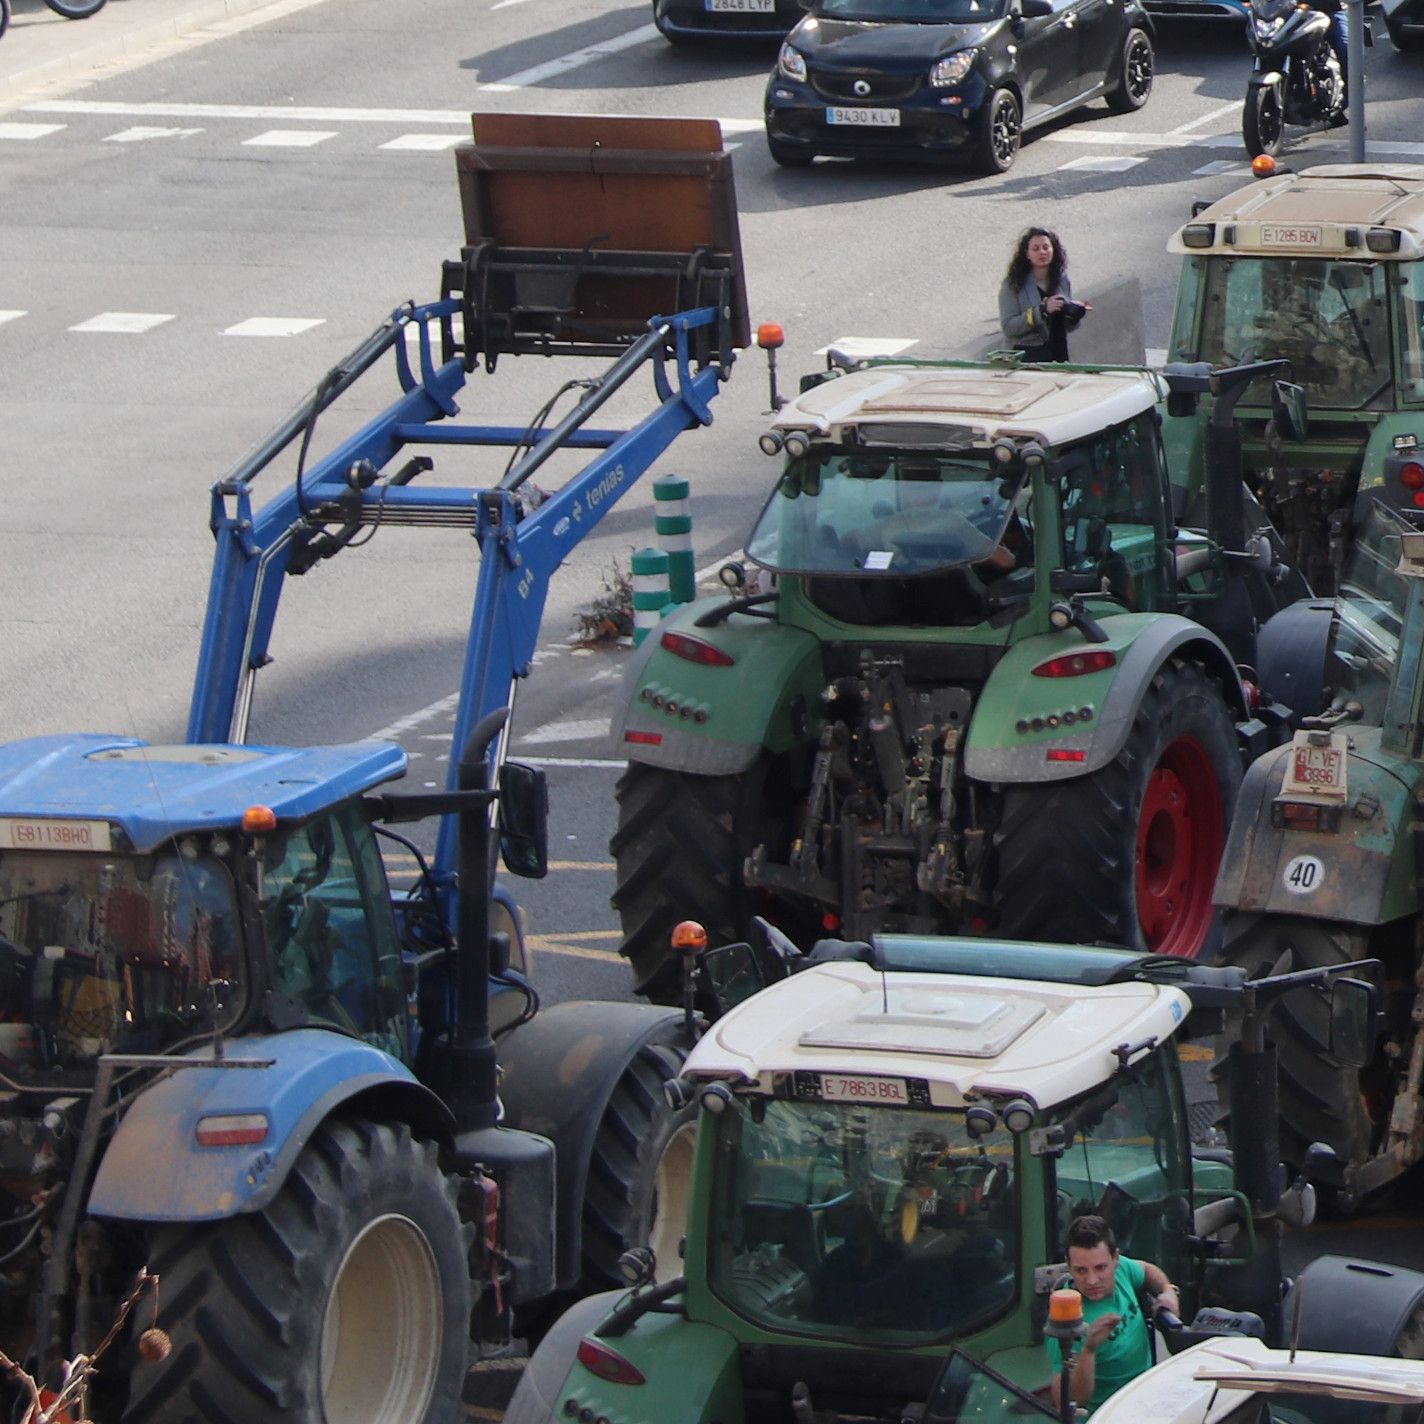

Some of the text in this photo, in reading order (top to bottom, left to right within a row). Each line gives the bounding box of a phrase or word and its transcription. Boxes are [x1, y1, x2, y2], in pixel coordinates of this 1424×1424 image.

[835, 107, 899, 124] 9430 KLV
[585, 463, 625, 510] tenias
[517, 567, 534, 600] B4
[1289, 861, 1316, 887] 40
[824, 1077, 907, 1099] E 7863 BGL
